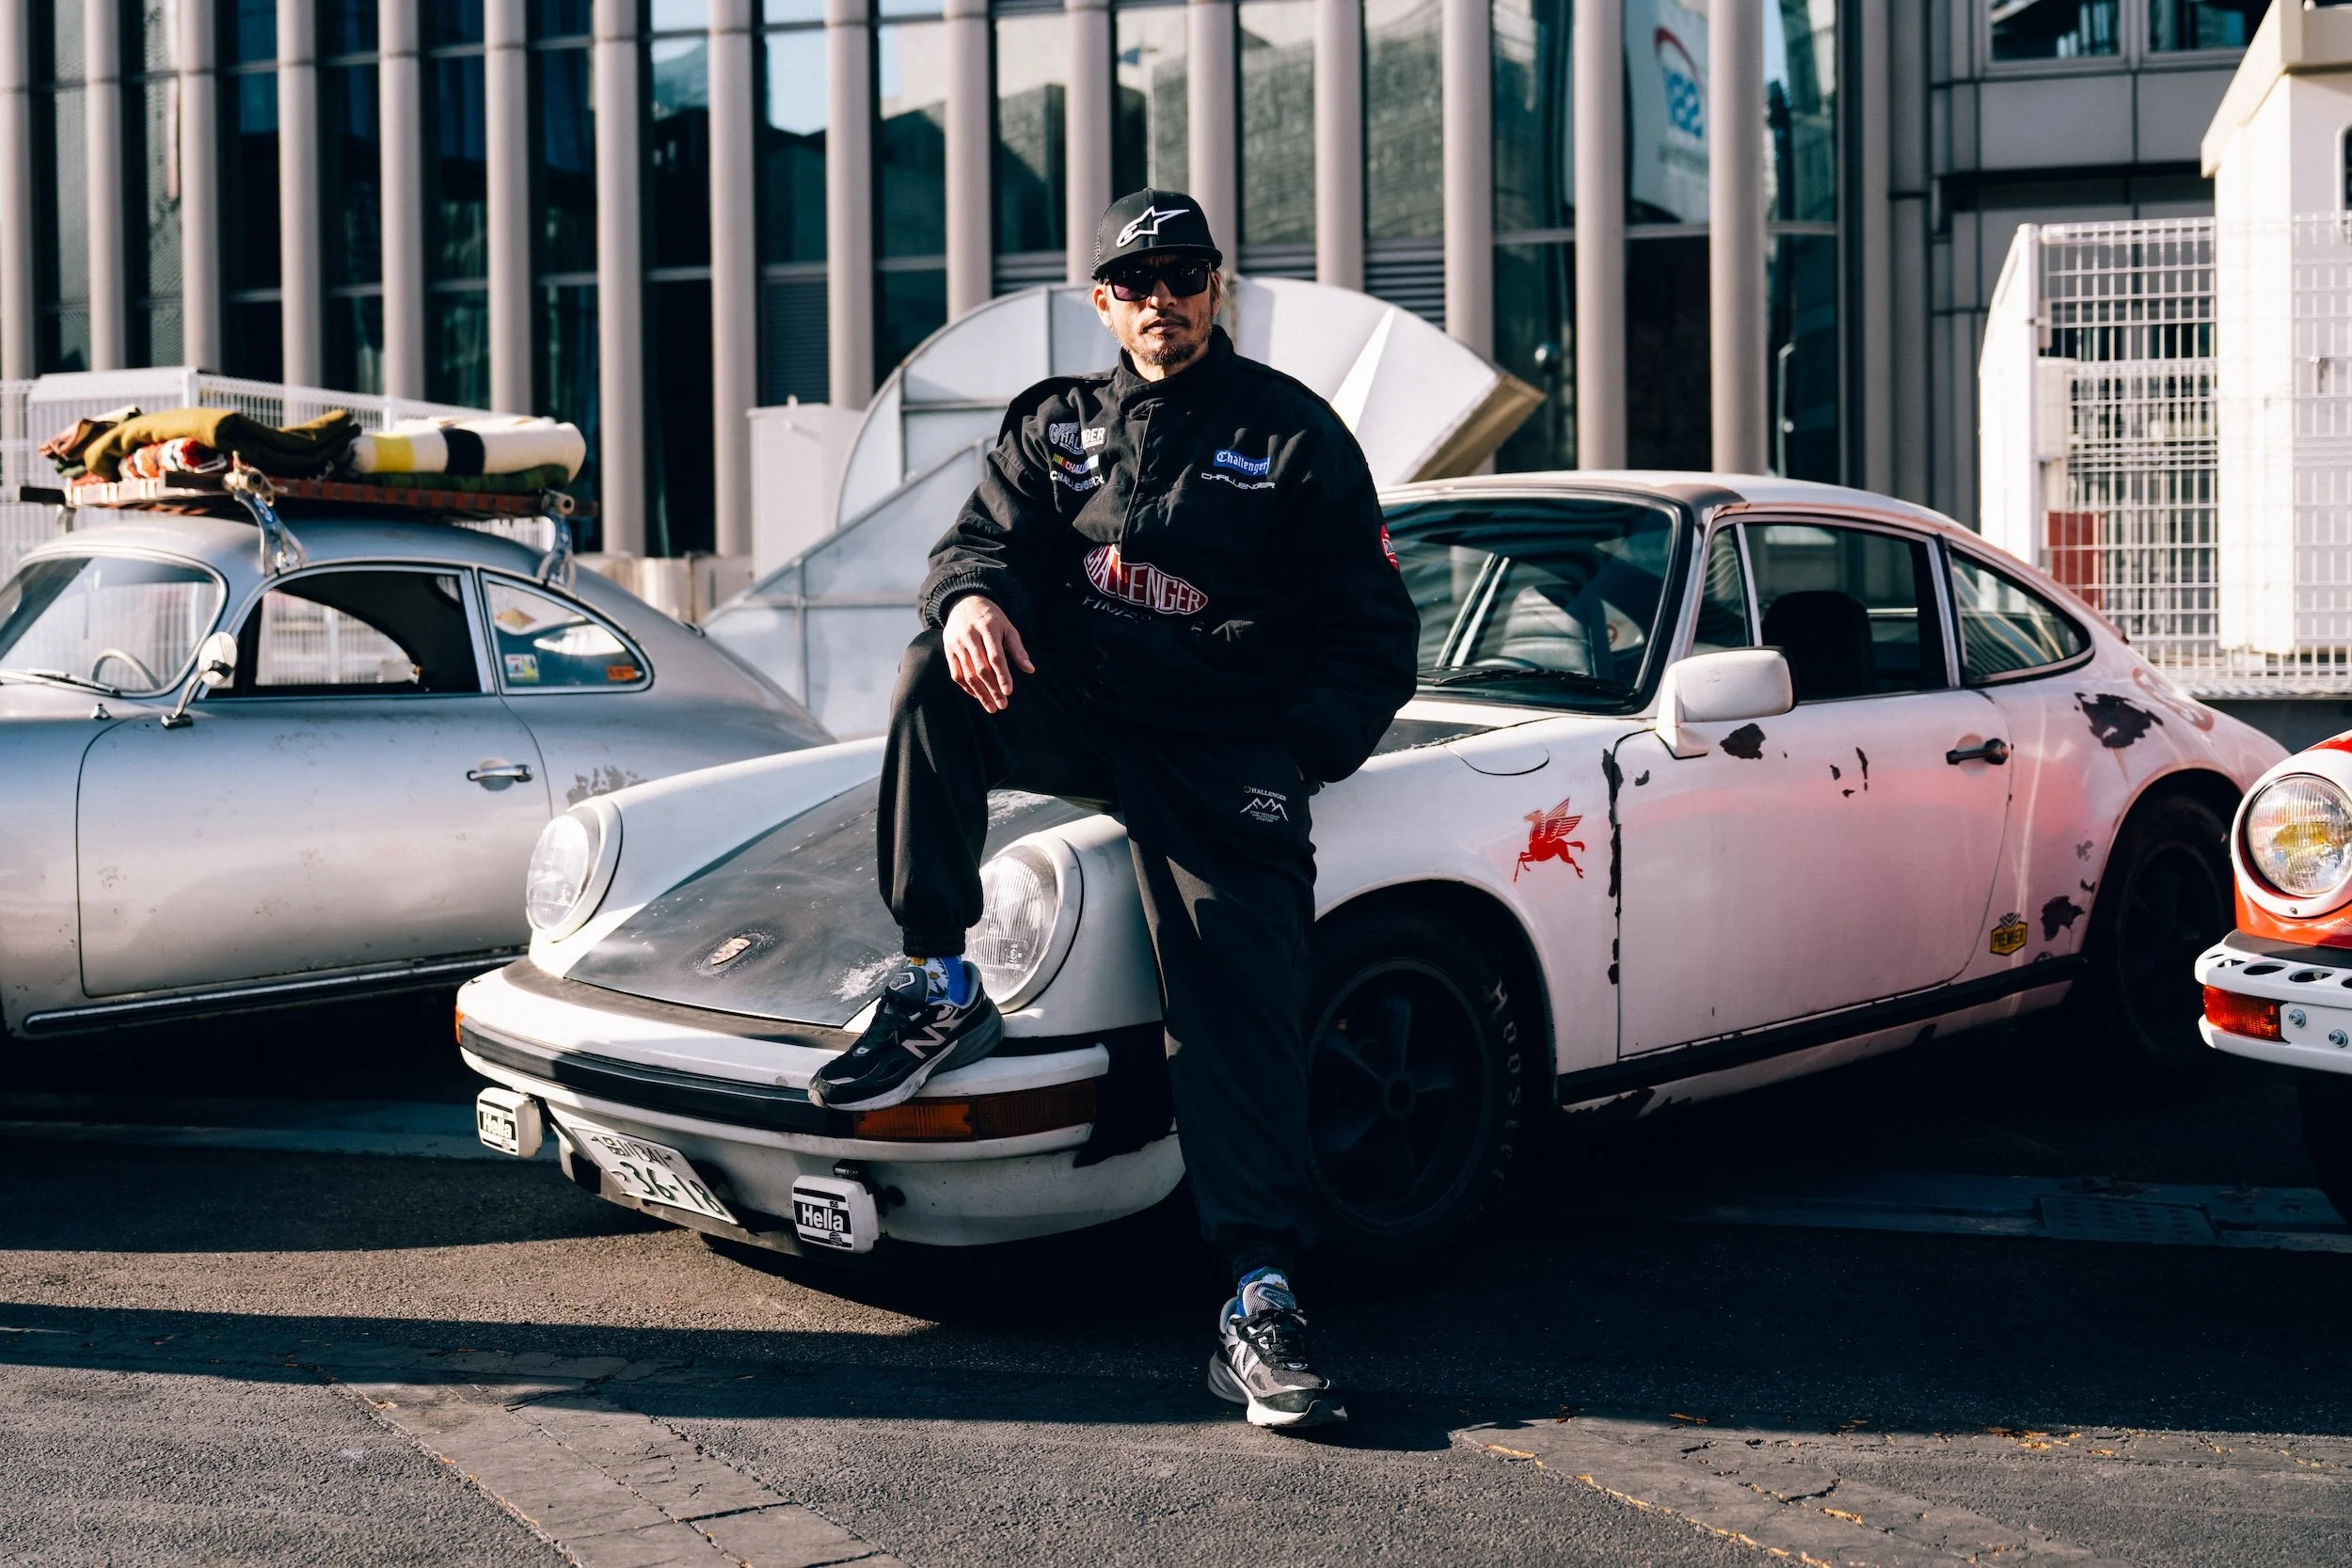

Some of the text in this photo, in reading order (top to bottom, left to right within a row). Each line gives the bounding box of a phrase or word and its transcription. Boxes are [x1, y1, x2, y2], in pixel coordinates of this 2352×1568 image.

[1049, 423, 1105, 450] CHALGER
[1201, 472, 1276, 490] CHALLENGER
[1087, 545, 1200, 611] CHALLENGER
[483, 1111, 513, 1139] Hella
[619, 1162, 724, 1215] 36-18
[802, 1203, 844, 1232] Hella
